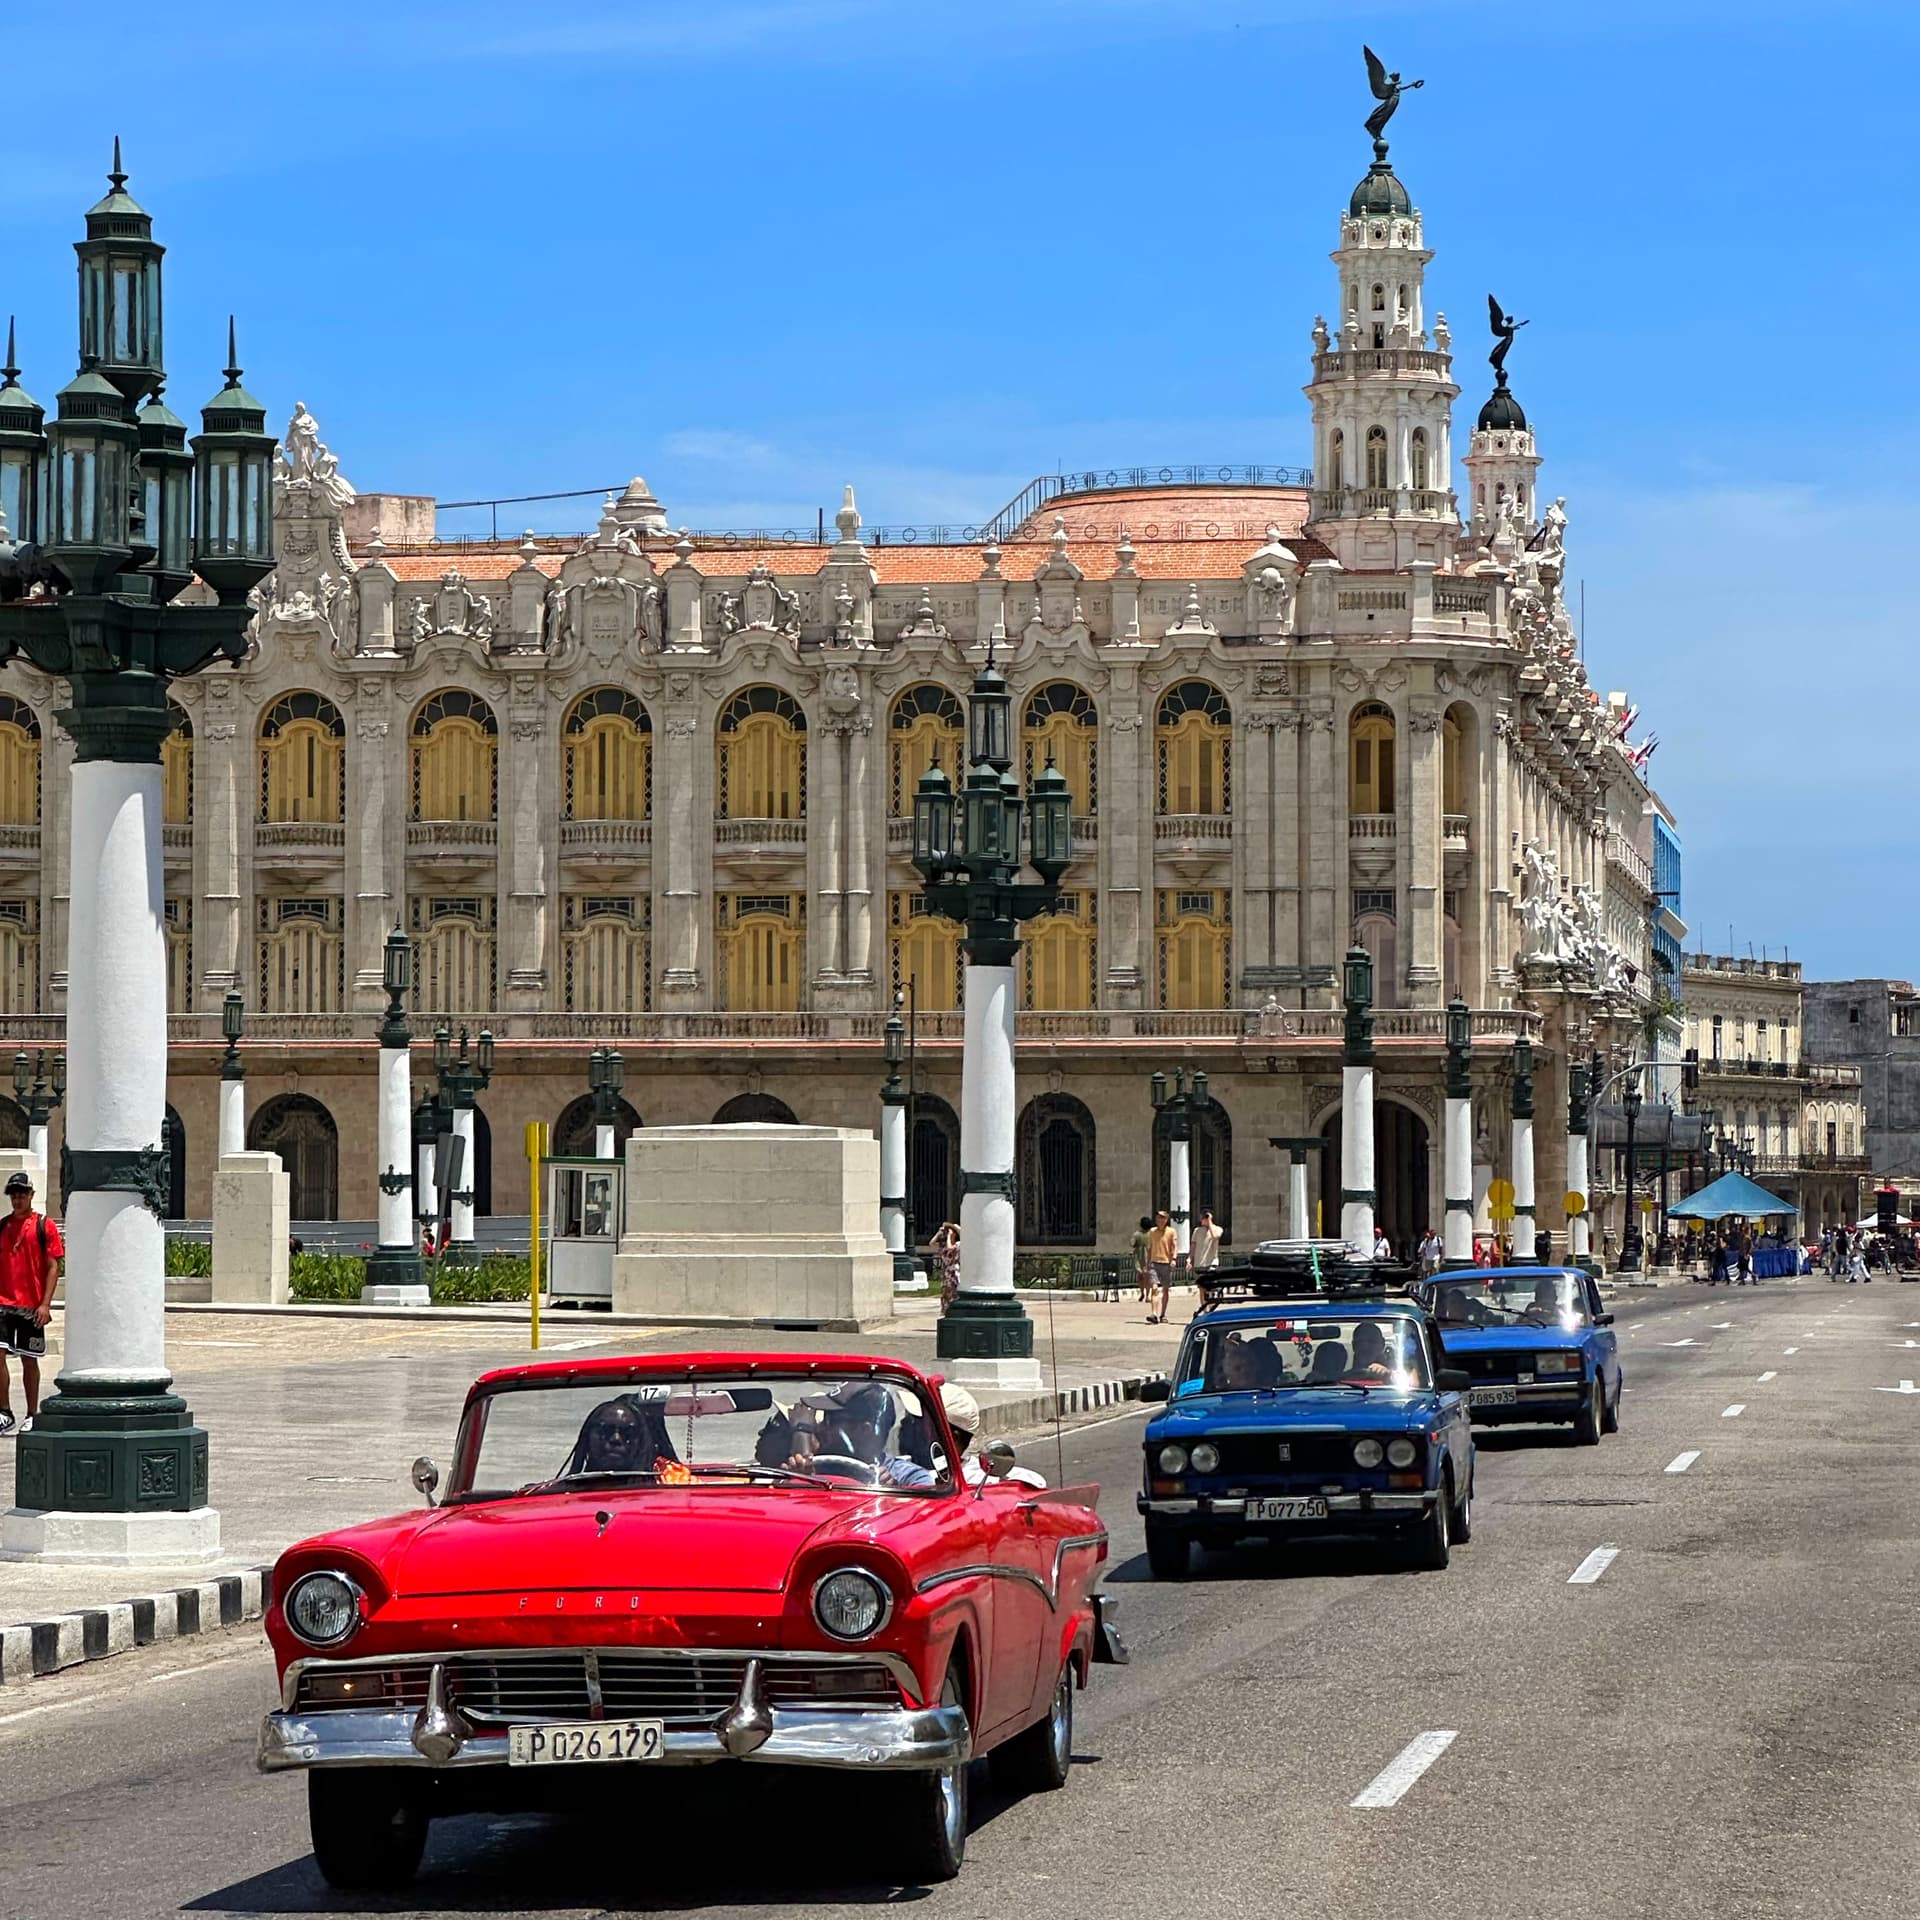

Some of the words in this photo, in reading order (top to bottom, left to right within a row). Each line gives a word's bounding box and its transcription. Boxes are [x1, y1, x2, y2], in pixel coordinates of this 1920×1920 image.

[642, 1387, 659, 1400] 17
[1257, 1502, 1265, 1518] P
[1269, 1502, 1294, 1518] 077
[1298, 1501, 1324, 1517] 250
[519, 1596, 639, 1609] FORD
[531, 1732, 545, 1761] P
[553, 1730, 601, 1760] 026
[608, 1727, 658, 1757] 179
